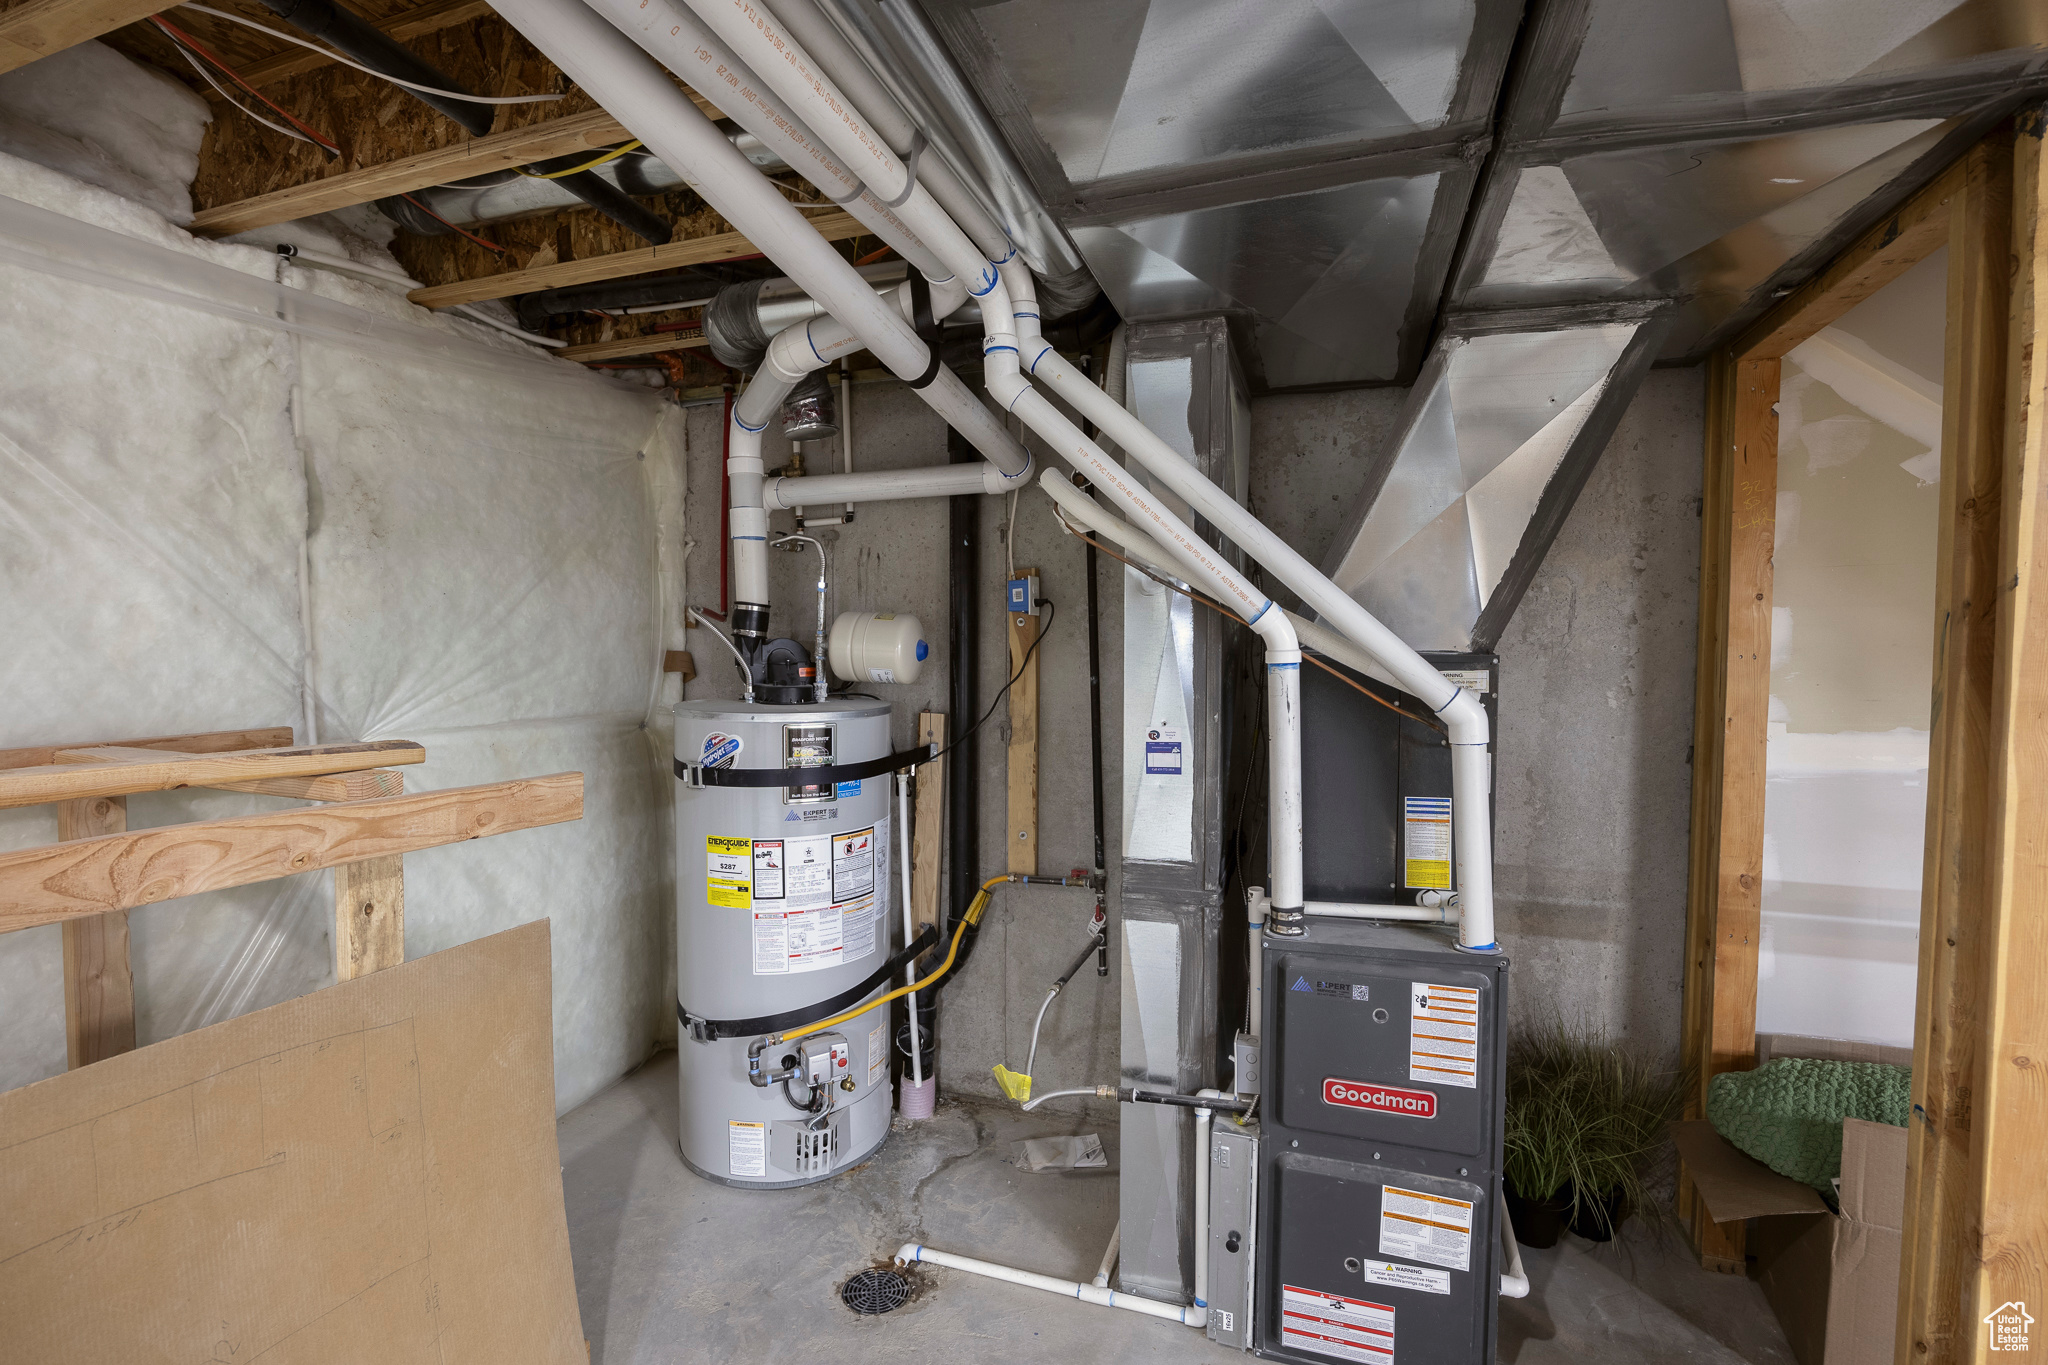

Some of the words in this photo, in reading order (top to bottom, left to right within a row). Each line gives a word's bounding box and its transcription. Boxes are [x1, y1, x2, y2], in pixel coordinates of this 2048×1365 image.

[739, 2, 760, 23] 73.4
[669, 24, 680, 36] D
[754, 17, 766, 29] @
[759, 24, 776, 40] PSI
[770, 35, 787, 52] 280
[692, 44, 713, 64] UG-1
[715, 63, 728, 76] 28
[723, 71, 740, 87] NXU
[739, 85, 757, 102] DWV
[810, 79, 828, 98] 1785
[822, 91, 844, 116] ASTM-D
[771, 114, 788, 130] 2665
[840, 111, 851, 123] 40
[846, 119, 860, 133] SCH
[783, 124, 806, 146] ASTM-D
[856, 130, 870, 144] 1120
[808, 146, 822, 159] 73.4
[865, 140, 879, 155] PVC
[818, 154, 827, 164] @
[823, 159, 835, 171] PSI
[859, 191, 872, 203] 1785
[868, 198, 885, 215] ASTM-D
[886, 214, 897, 225] SCH
[1094, 462, 1107, 474] PVC
[1104, 471, 1117, 483] 1120
[1115, 480, 1127, 493] SCH
[1124, 489, 1133, 498] 40
[1131, 495, 1151, 513] ASTM-D
[1148, 510, 1161, 522] 1785
[1183, 541, 1194, 552] 280
[1191, 548, 1202, 559] PSI
[1219, 574, 1239, 593] ASTM-D
[1236, 588, 1249, 601] 2665
[1317, 982, 1350, 990] EXPERT
[1331, 1084, 1429, 1112] Goodman
[1396, 1273, 1425, 1282] Reproductive
